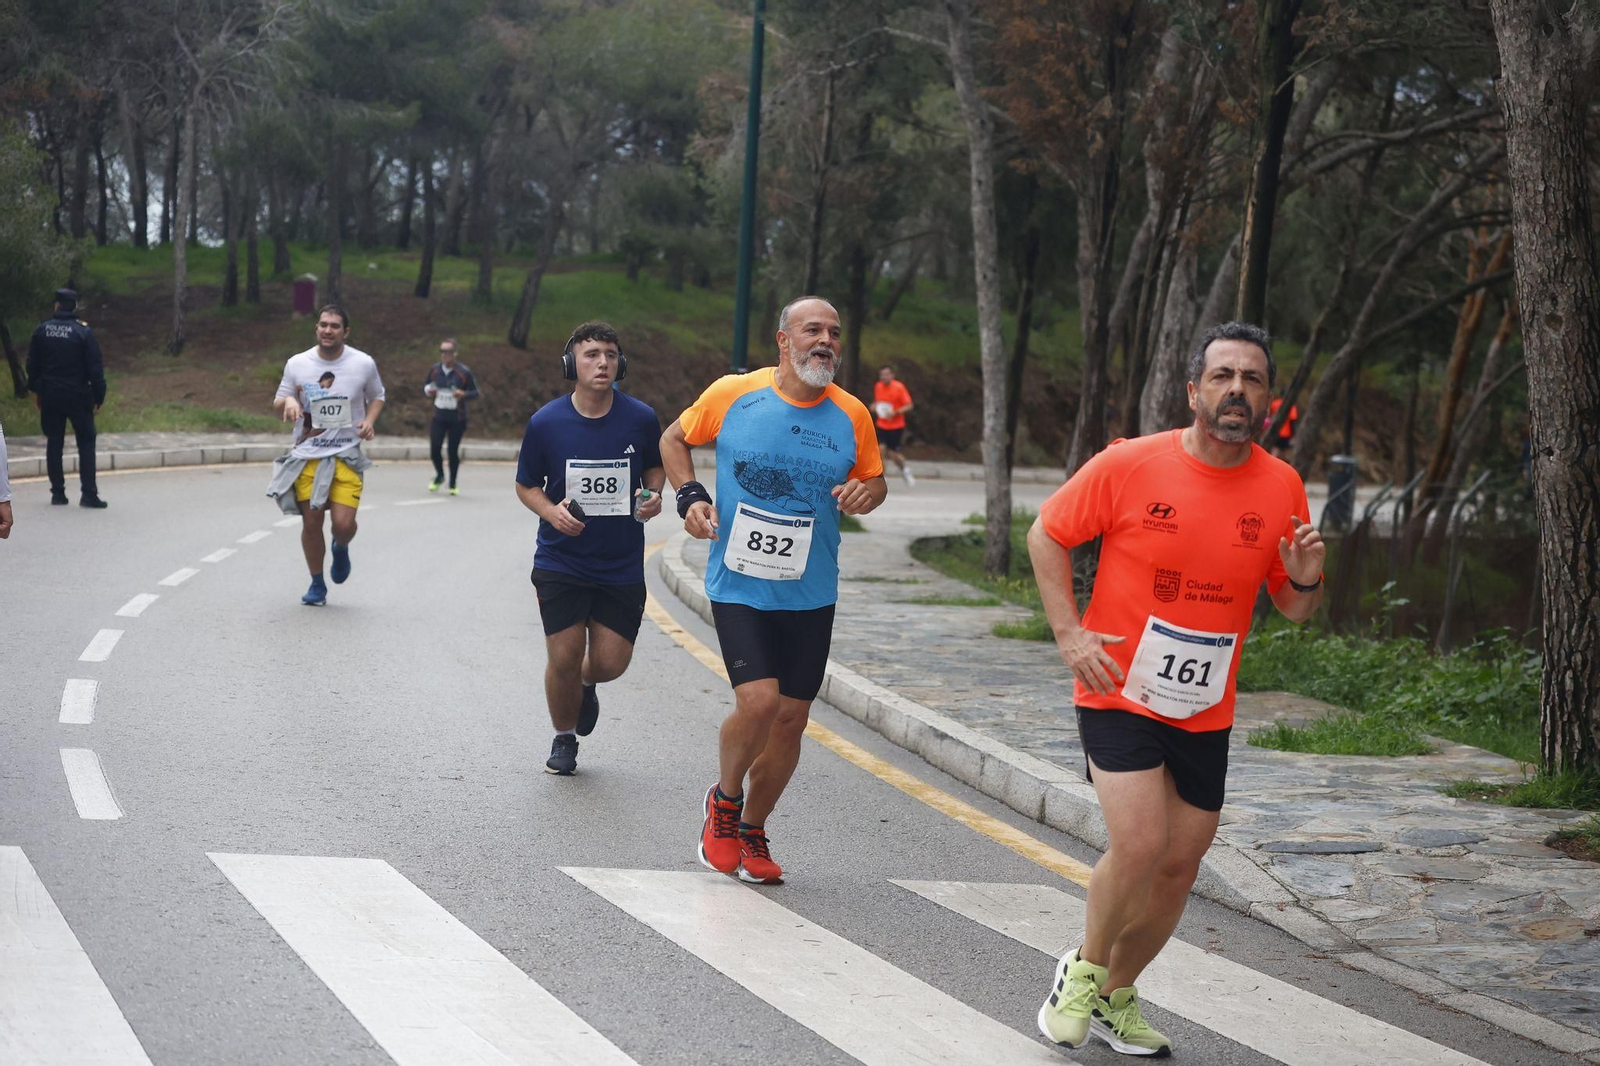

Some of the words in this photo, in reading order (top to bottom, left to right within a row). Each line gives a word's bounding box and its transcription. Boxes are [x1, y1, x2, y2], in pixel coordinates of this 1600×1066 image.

[45, 330, 69, 339] LOCAL
[319, 405, 342, 416] 407
[802, 429, 827, 439] ZURICH
[581, 477, 618, 494] 368
[1142, 519, 1179, 531] HYUNDAI
[747, 530, 794, 557] 832
[1186, 580, 1223, 592] Ciudad
[1184, 591, 1197, 601] de
[1199, 593, 1233, 605] Málaga
[1157, 654, 1212, 687] 161
